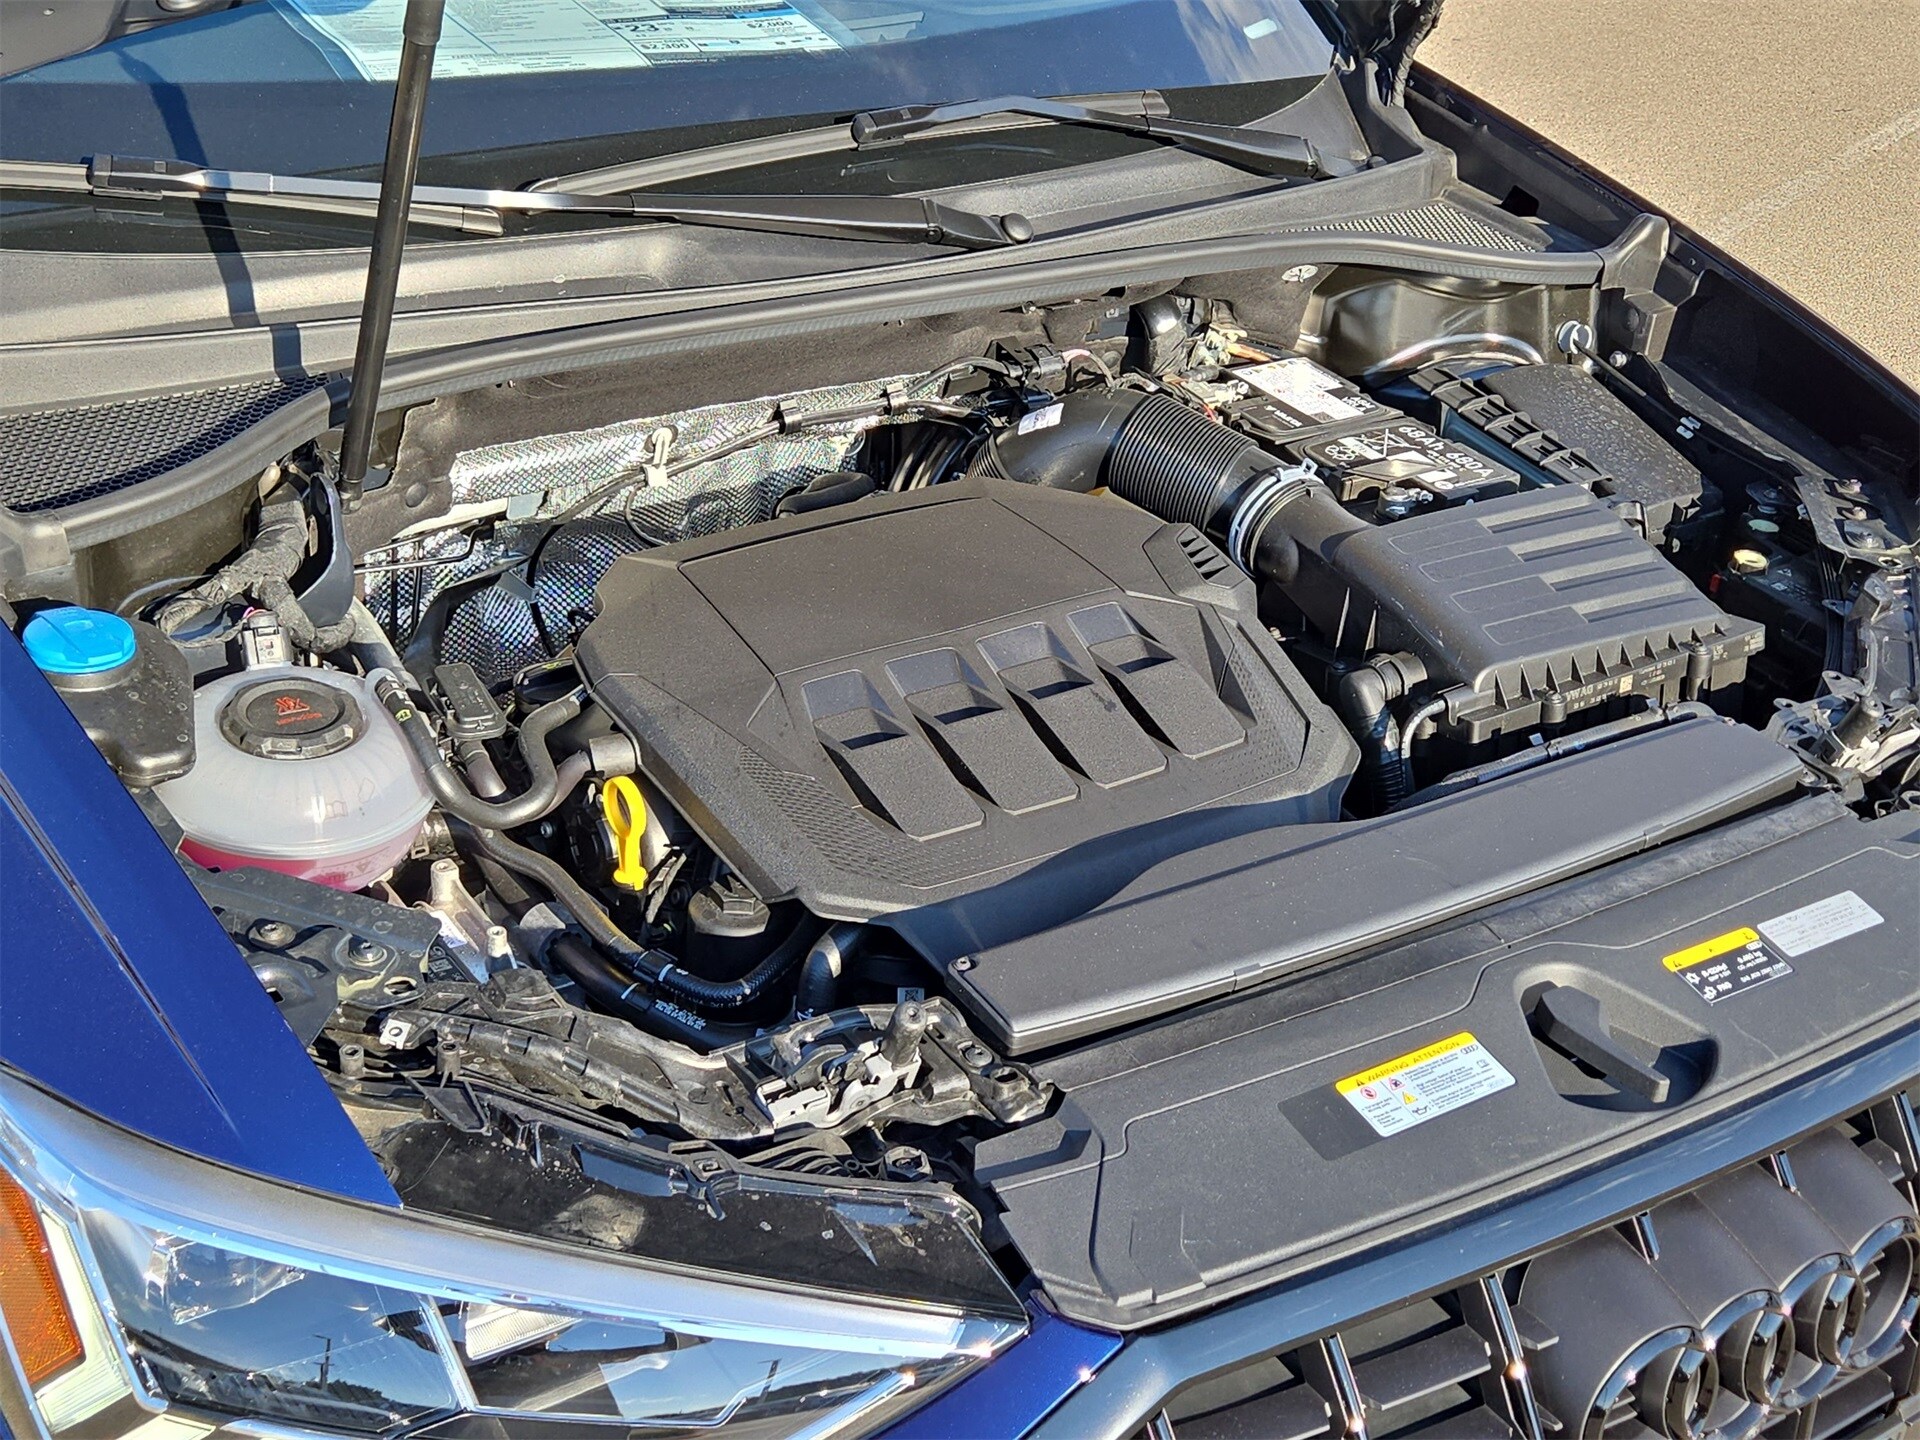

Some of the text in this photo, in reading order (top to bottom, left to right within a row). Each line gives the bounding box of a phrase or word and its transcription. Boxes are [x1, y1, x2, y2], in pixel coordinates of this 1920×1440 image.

[1398, 426, 1445, 451] 68Ah
[1445, 452, 1494, 478] 680A
[1412, 1041, 1461, 1064] ATTENTION
